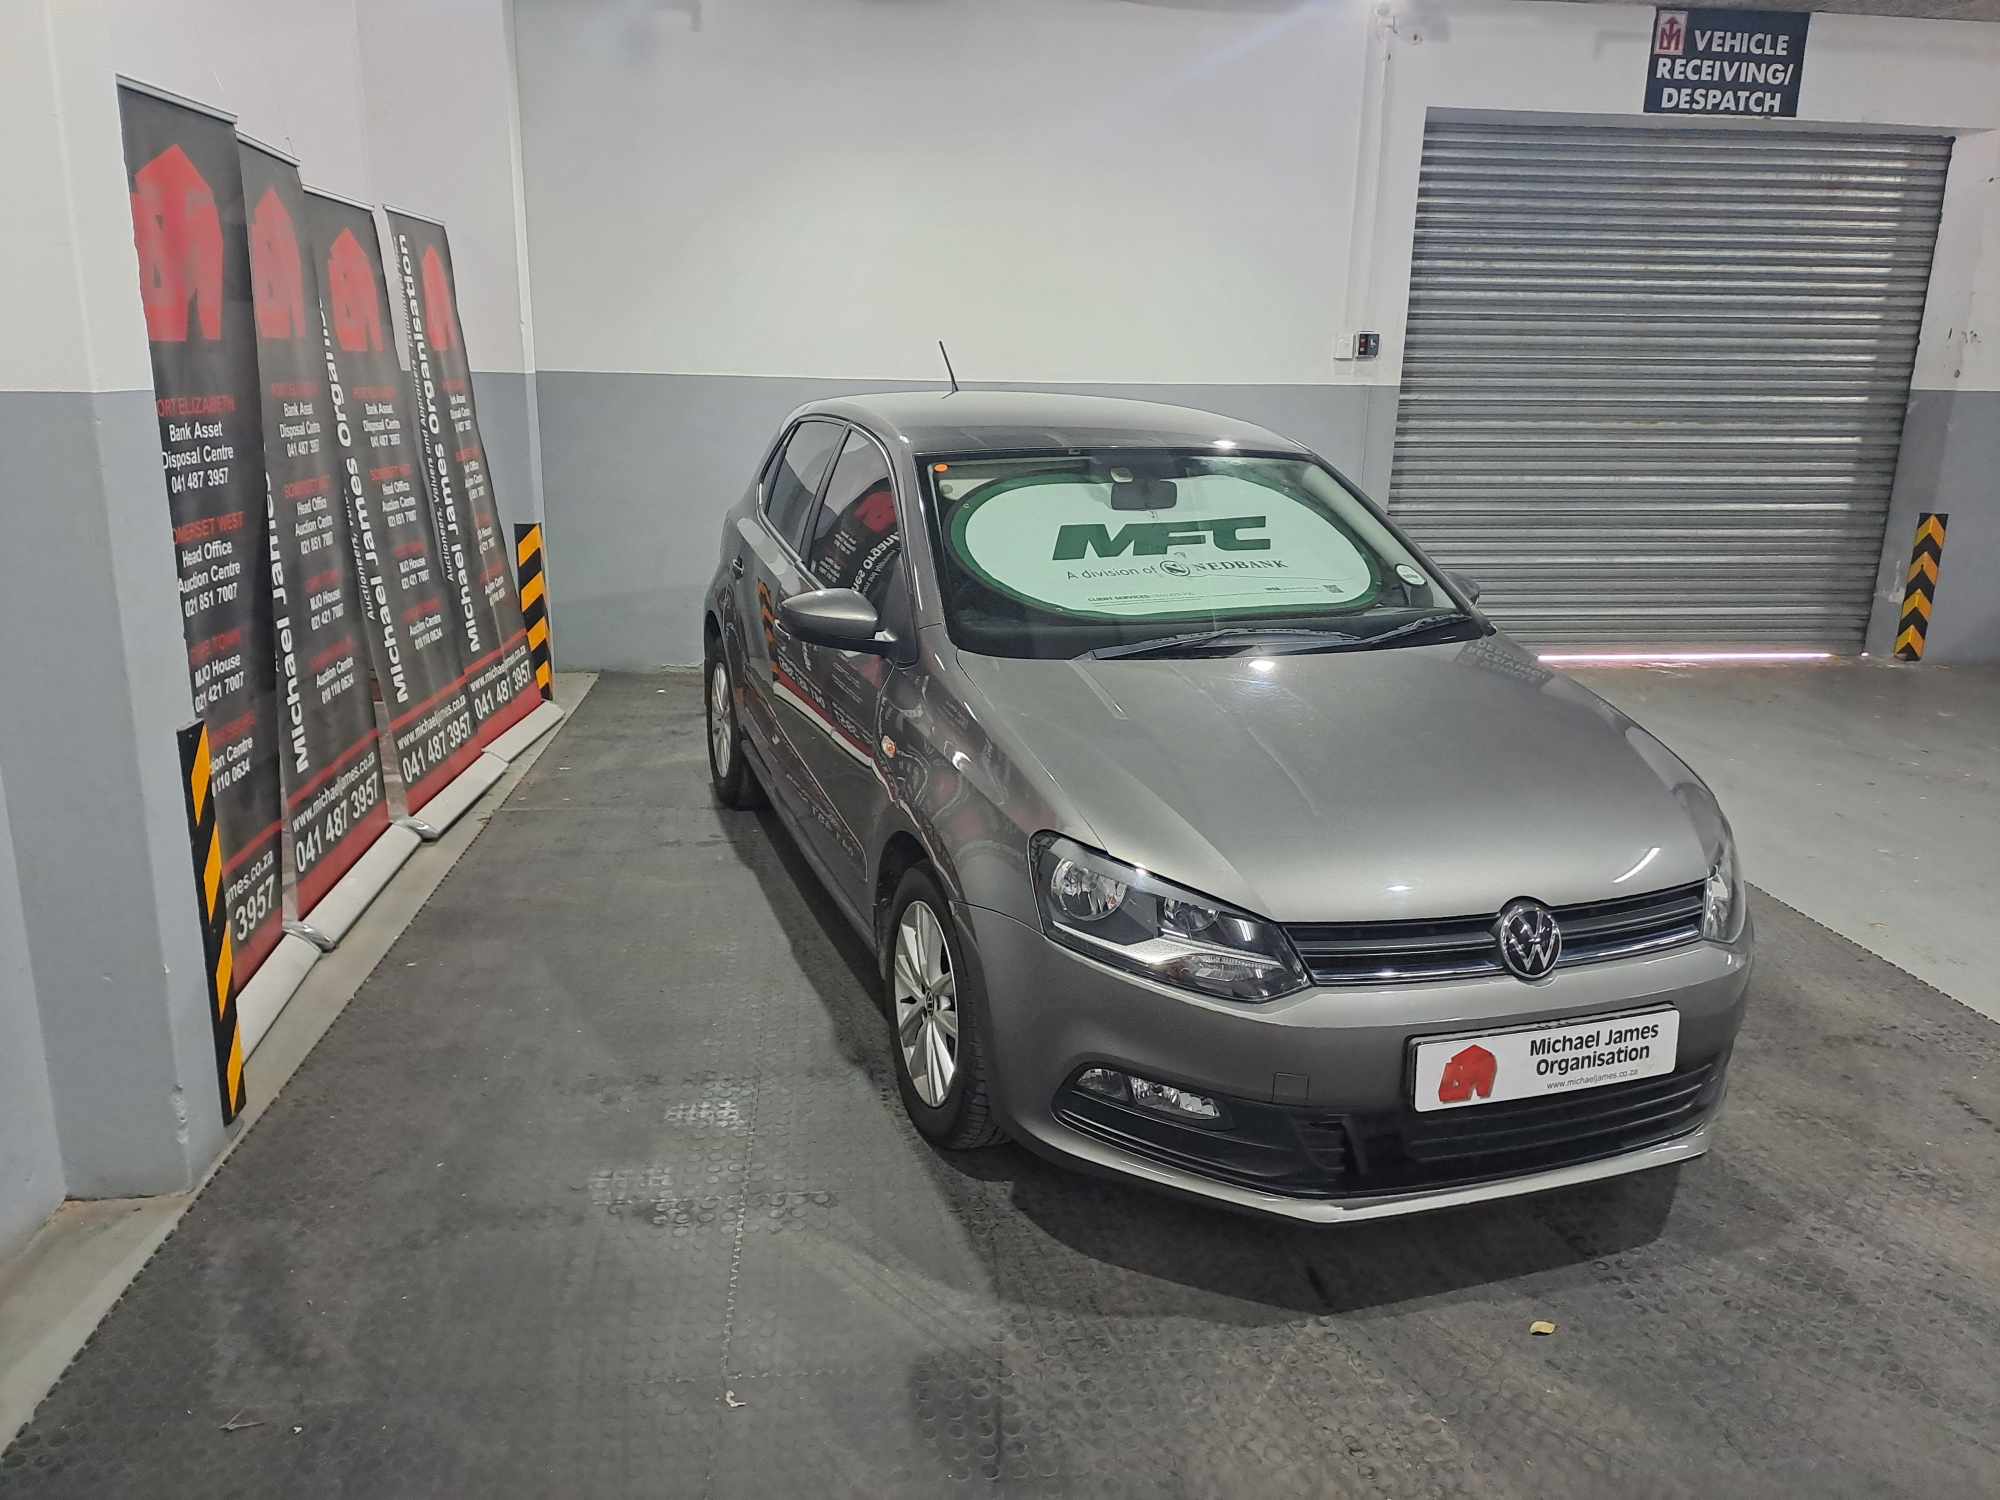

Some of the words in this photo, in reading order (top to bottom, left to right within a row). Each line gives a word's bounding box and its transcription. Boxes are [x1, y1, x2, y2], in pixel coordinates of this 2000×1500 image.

[1693, 29, 1790, 55] VEHICLE
[1655, 57, 1794, 85] RECEIVING/
[1660, 87, 1782, 113] DESPATCH
[399, 234, 440, 435] Organisation
[168, 422, 192, 441] Bank
[194, 420, 223, 439] Asset
[161, 446, 200, 470] Disposal
[203, 444, 234, 462] Centre
[171, 474, 186, 493] 041
[187, 471, 204, 489] 487
[207, 467, 229, 486] 3957
[434, 442, 459, 536] James
[346, 457, 379, 567] James
[182, 546, 202, 568] Head
[204, 540, 233, 560] Office
[1052, 515, 1271, 560] MFC
[178, 571, 208, 593] Auction
[210, 561, 240, 581] Centre
[1066, 571, 1079, 581] A
[1081, 566, 1139, 580] division
[1142, 565, 1160, 575] of
[1193, 559, 1288, 572] NEDBANK
[184, 597, 198, 617] 021
[216, 582, 238, 604] 7007
[450, 543, 480, 652] Michael
[370, 575, 409, 703] Michael
[212, 654, 240, 677] House
[224, 671, 245, 694] 7007
[276, 616, 309, 774] Michael
[474, 689, 495, 720] 041
[512, 659, 531, 690] 3957
[227, 736, 253, 762] Centre
[402, 746, 426, 783] 041
[427, 731, 447, 763] 487
[447, 711, 471, 748] 3957
[296, 824, 322, 872] 041
[325, 799, 348, 842] 487
[351, 771, 378, 818] 3957
[235, 873, 275, 941] 3957
[1529, 1030, 1600, 1057] Michael
[1604, 1023, 1660, 1046] James
[1536, 1044, 1651, 1076] Organisation
